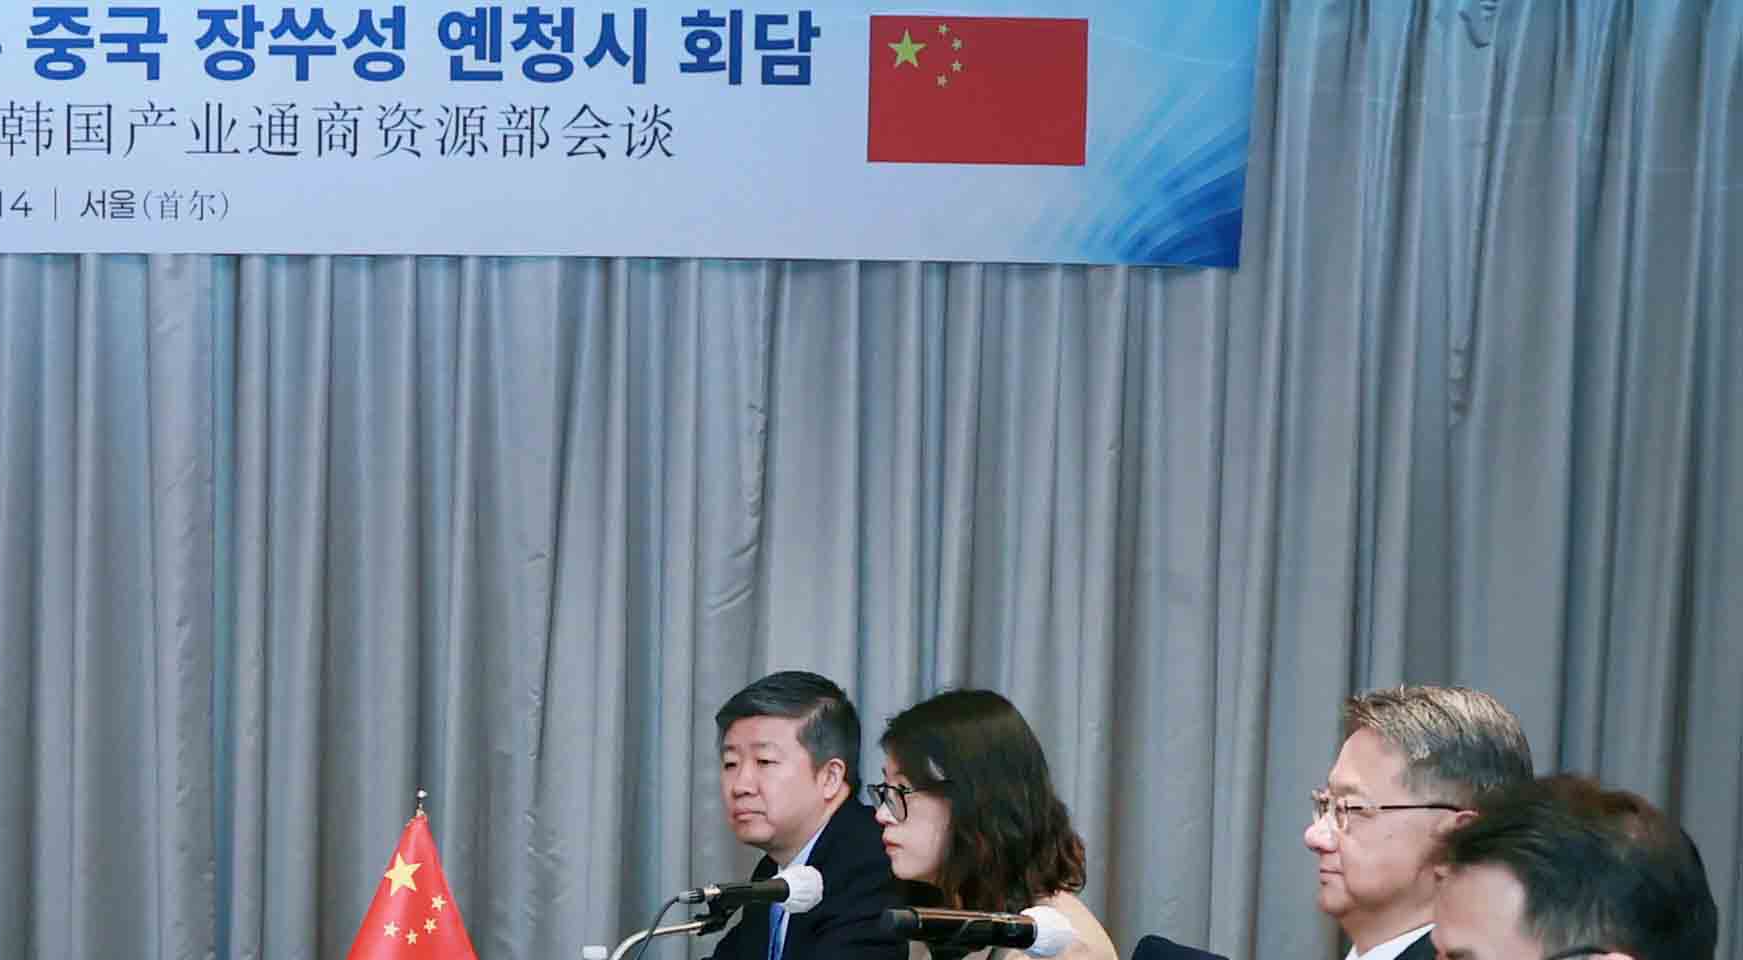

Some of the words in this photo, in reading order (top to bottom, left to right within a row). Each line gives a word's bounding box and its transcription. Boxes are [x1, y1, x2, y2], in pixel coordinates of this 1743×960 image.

[27, 6, 168, 81] 중국
[195, 5, 407, 82] 장쑤성
[438, 6, 648, 85] 옌청시
[679, 9, 821, 86] 회담
